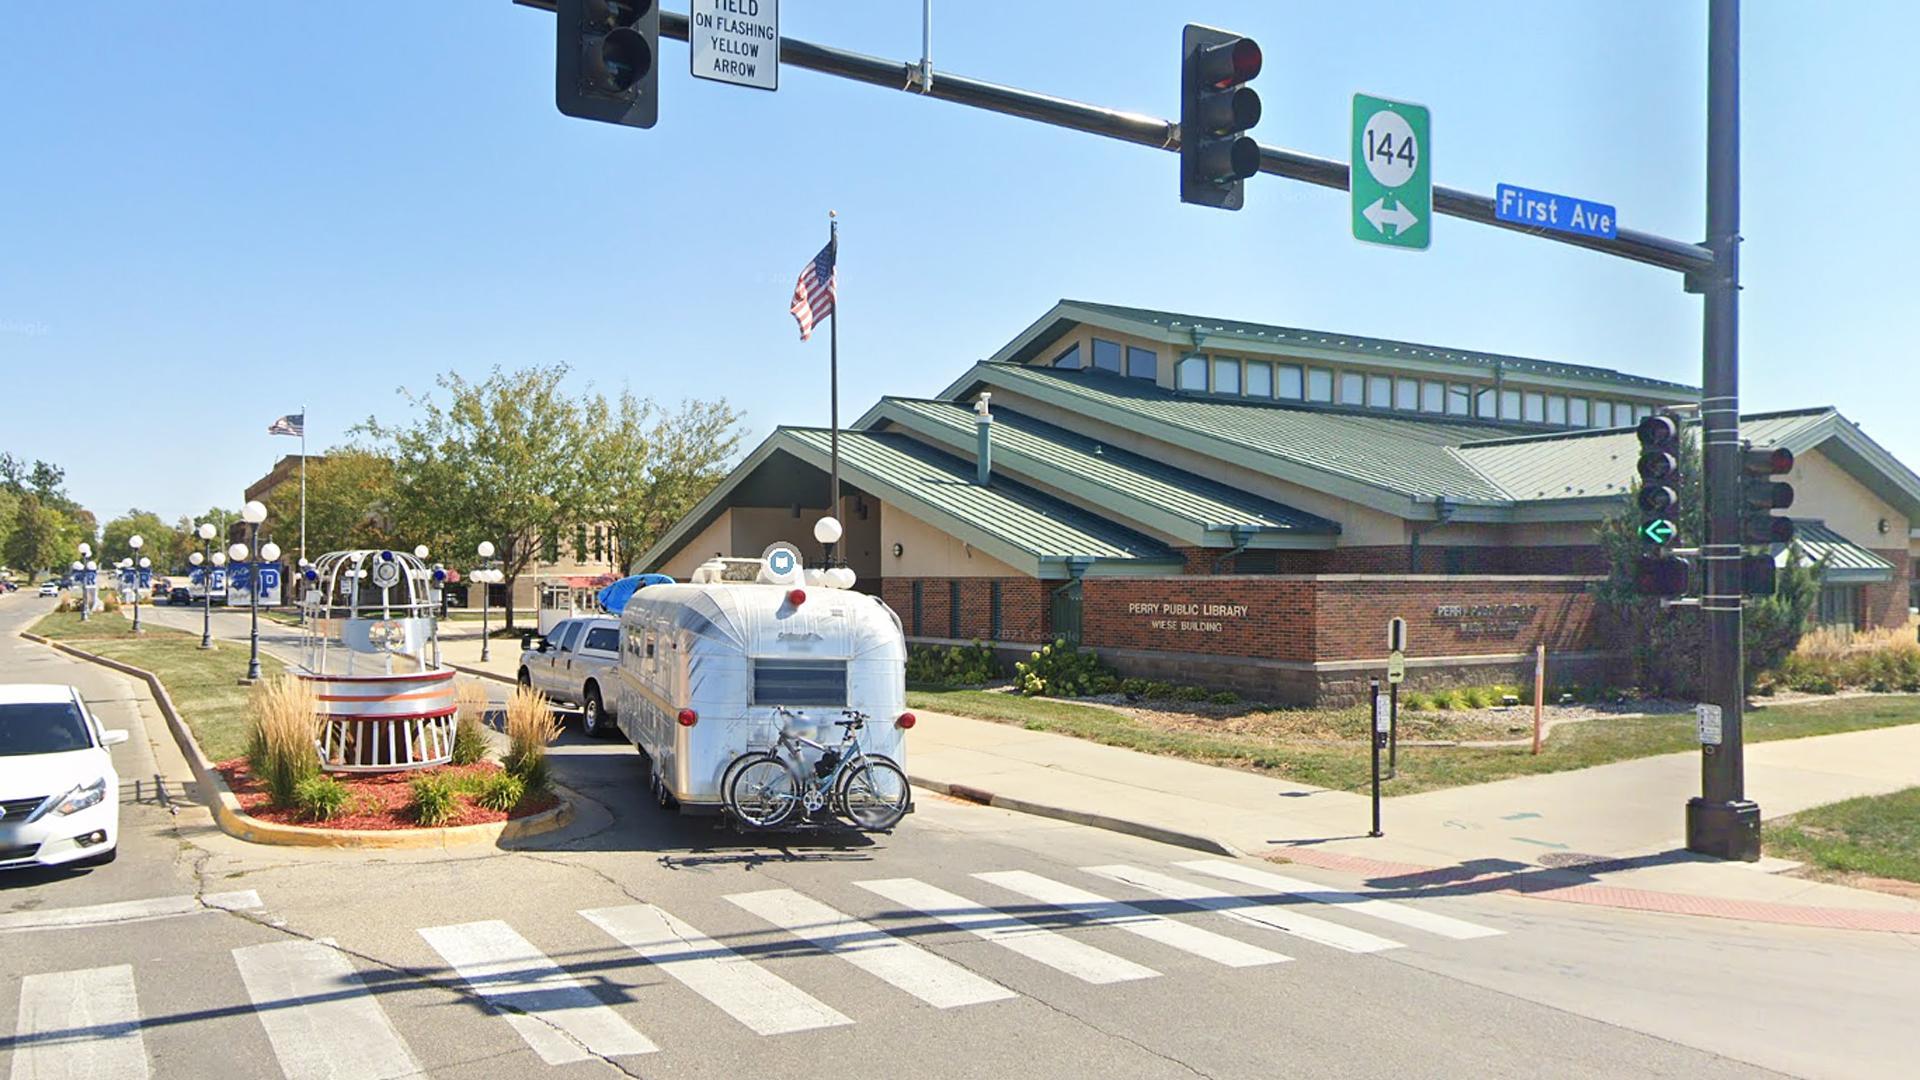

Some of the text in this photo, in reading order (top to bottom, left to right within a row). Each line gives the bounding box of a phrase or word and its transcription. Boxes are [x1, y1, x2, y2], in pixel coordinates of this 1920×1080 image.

[695, 12, 774, 40] ON FLASHING
[711, 36, 759, 58] YELLOW
[713, 58, 756, 78] ARROW
[1367, 129, 1415, 168] 144
[1502, 189, 1611, 233] First Ave
[259, 568, 280, 598] P
[1129, 603, 1249, 617] PERRY PUBLIC LIBRARY
[1152, 620, 1223, 632] WIESE BUILDING
